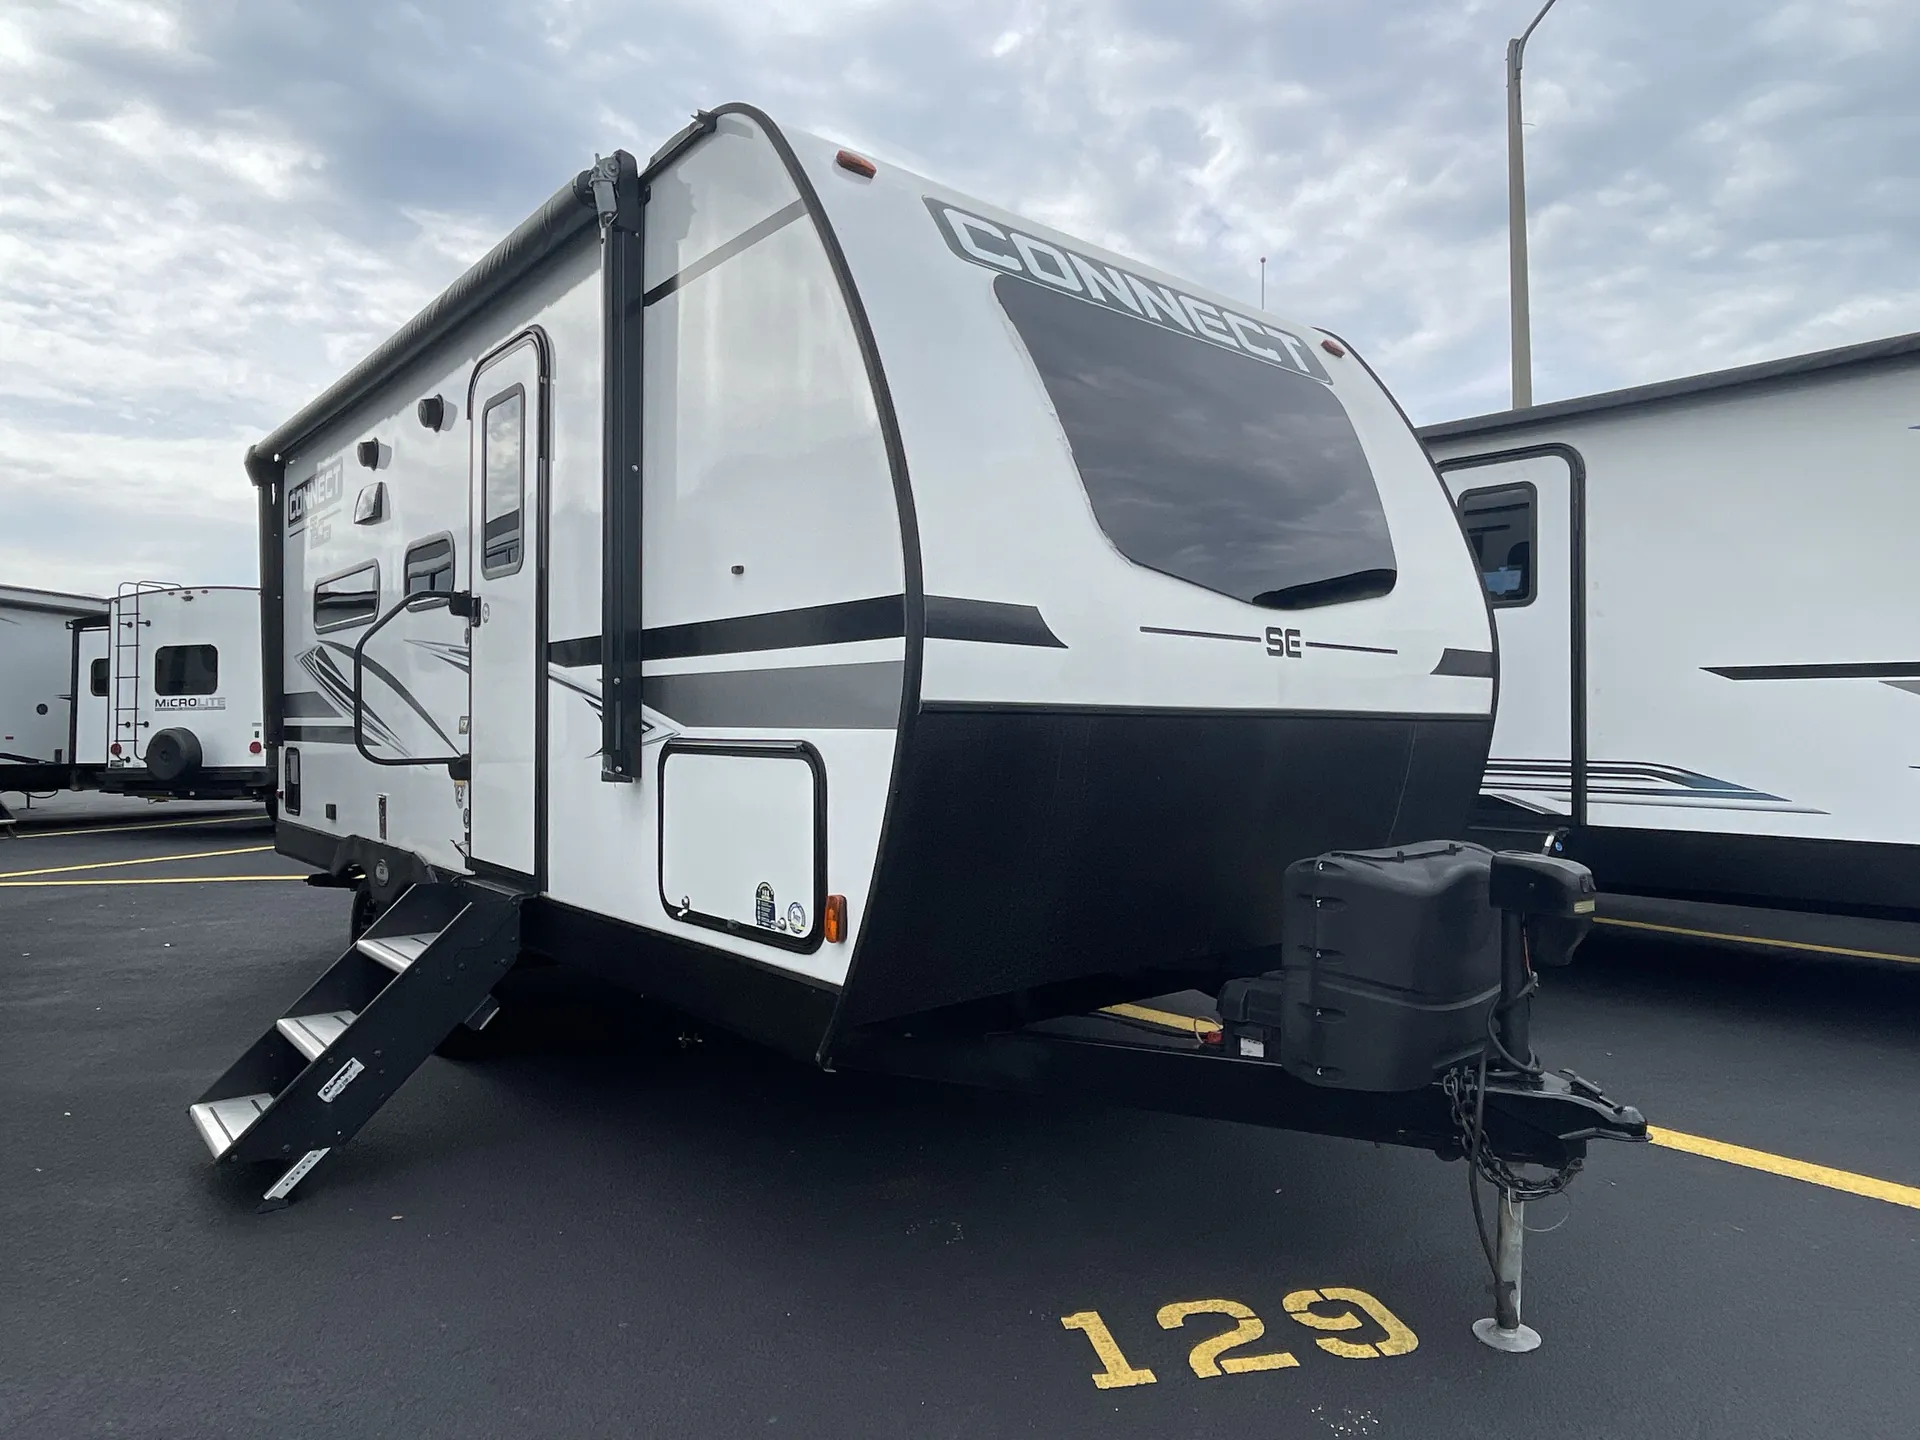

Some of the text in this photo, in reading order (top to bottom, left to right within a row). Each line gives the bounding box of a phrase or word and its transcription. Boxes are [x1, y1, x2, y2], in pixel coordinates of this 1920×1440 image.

[942, 207, 1311, 374] CONNECT
[289, 463, 342, 521] CONNECT
[1265, 626, 1302, 658] SE
[1061, 1287, 1419, 1389] 129
